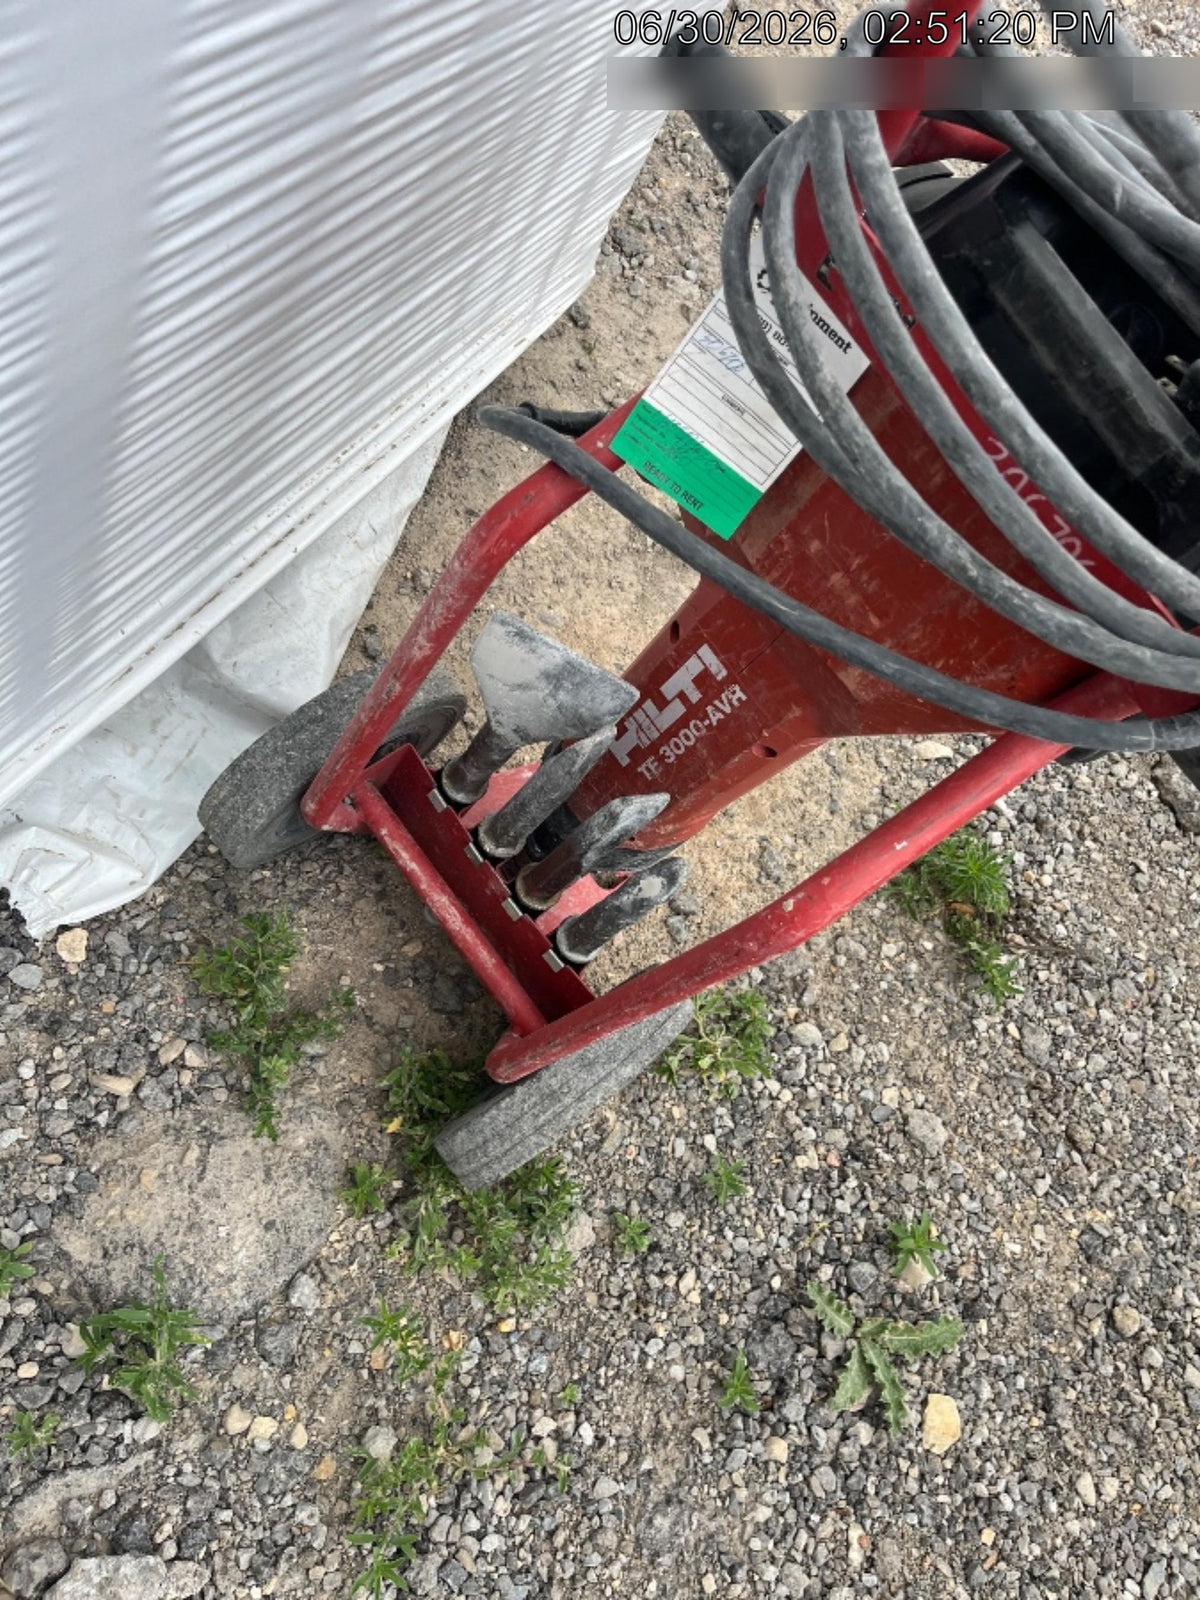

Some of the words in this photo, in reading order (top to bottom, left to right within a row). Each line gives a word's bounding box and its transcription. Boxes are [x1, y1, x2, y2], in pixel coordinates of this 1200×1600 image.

[643, 461, 671, 487] READY
[670, 481, 684, 496] TO
[682, 490, 704, 511] RENT
[608, 643, 728, 767] HILTI
[659, 683, 748, 764] 3000-AVR
